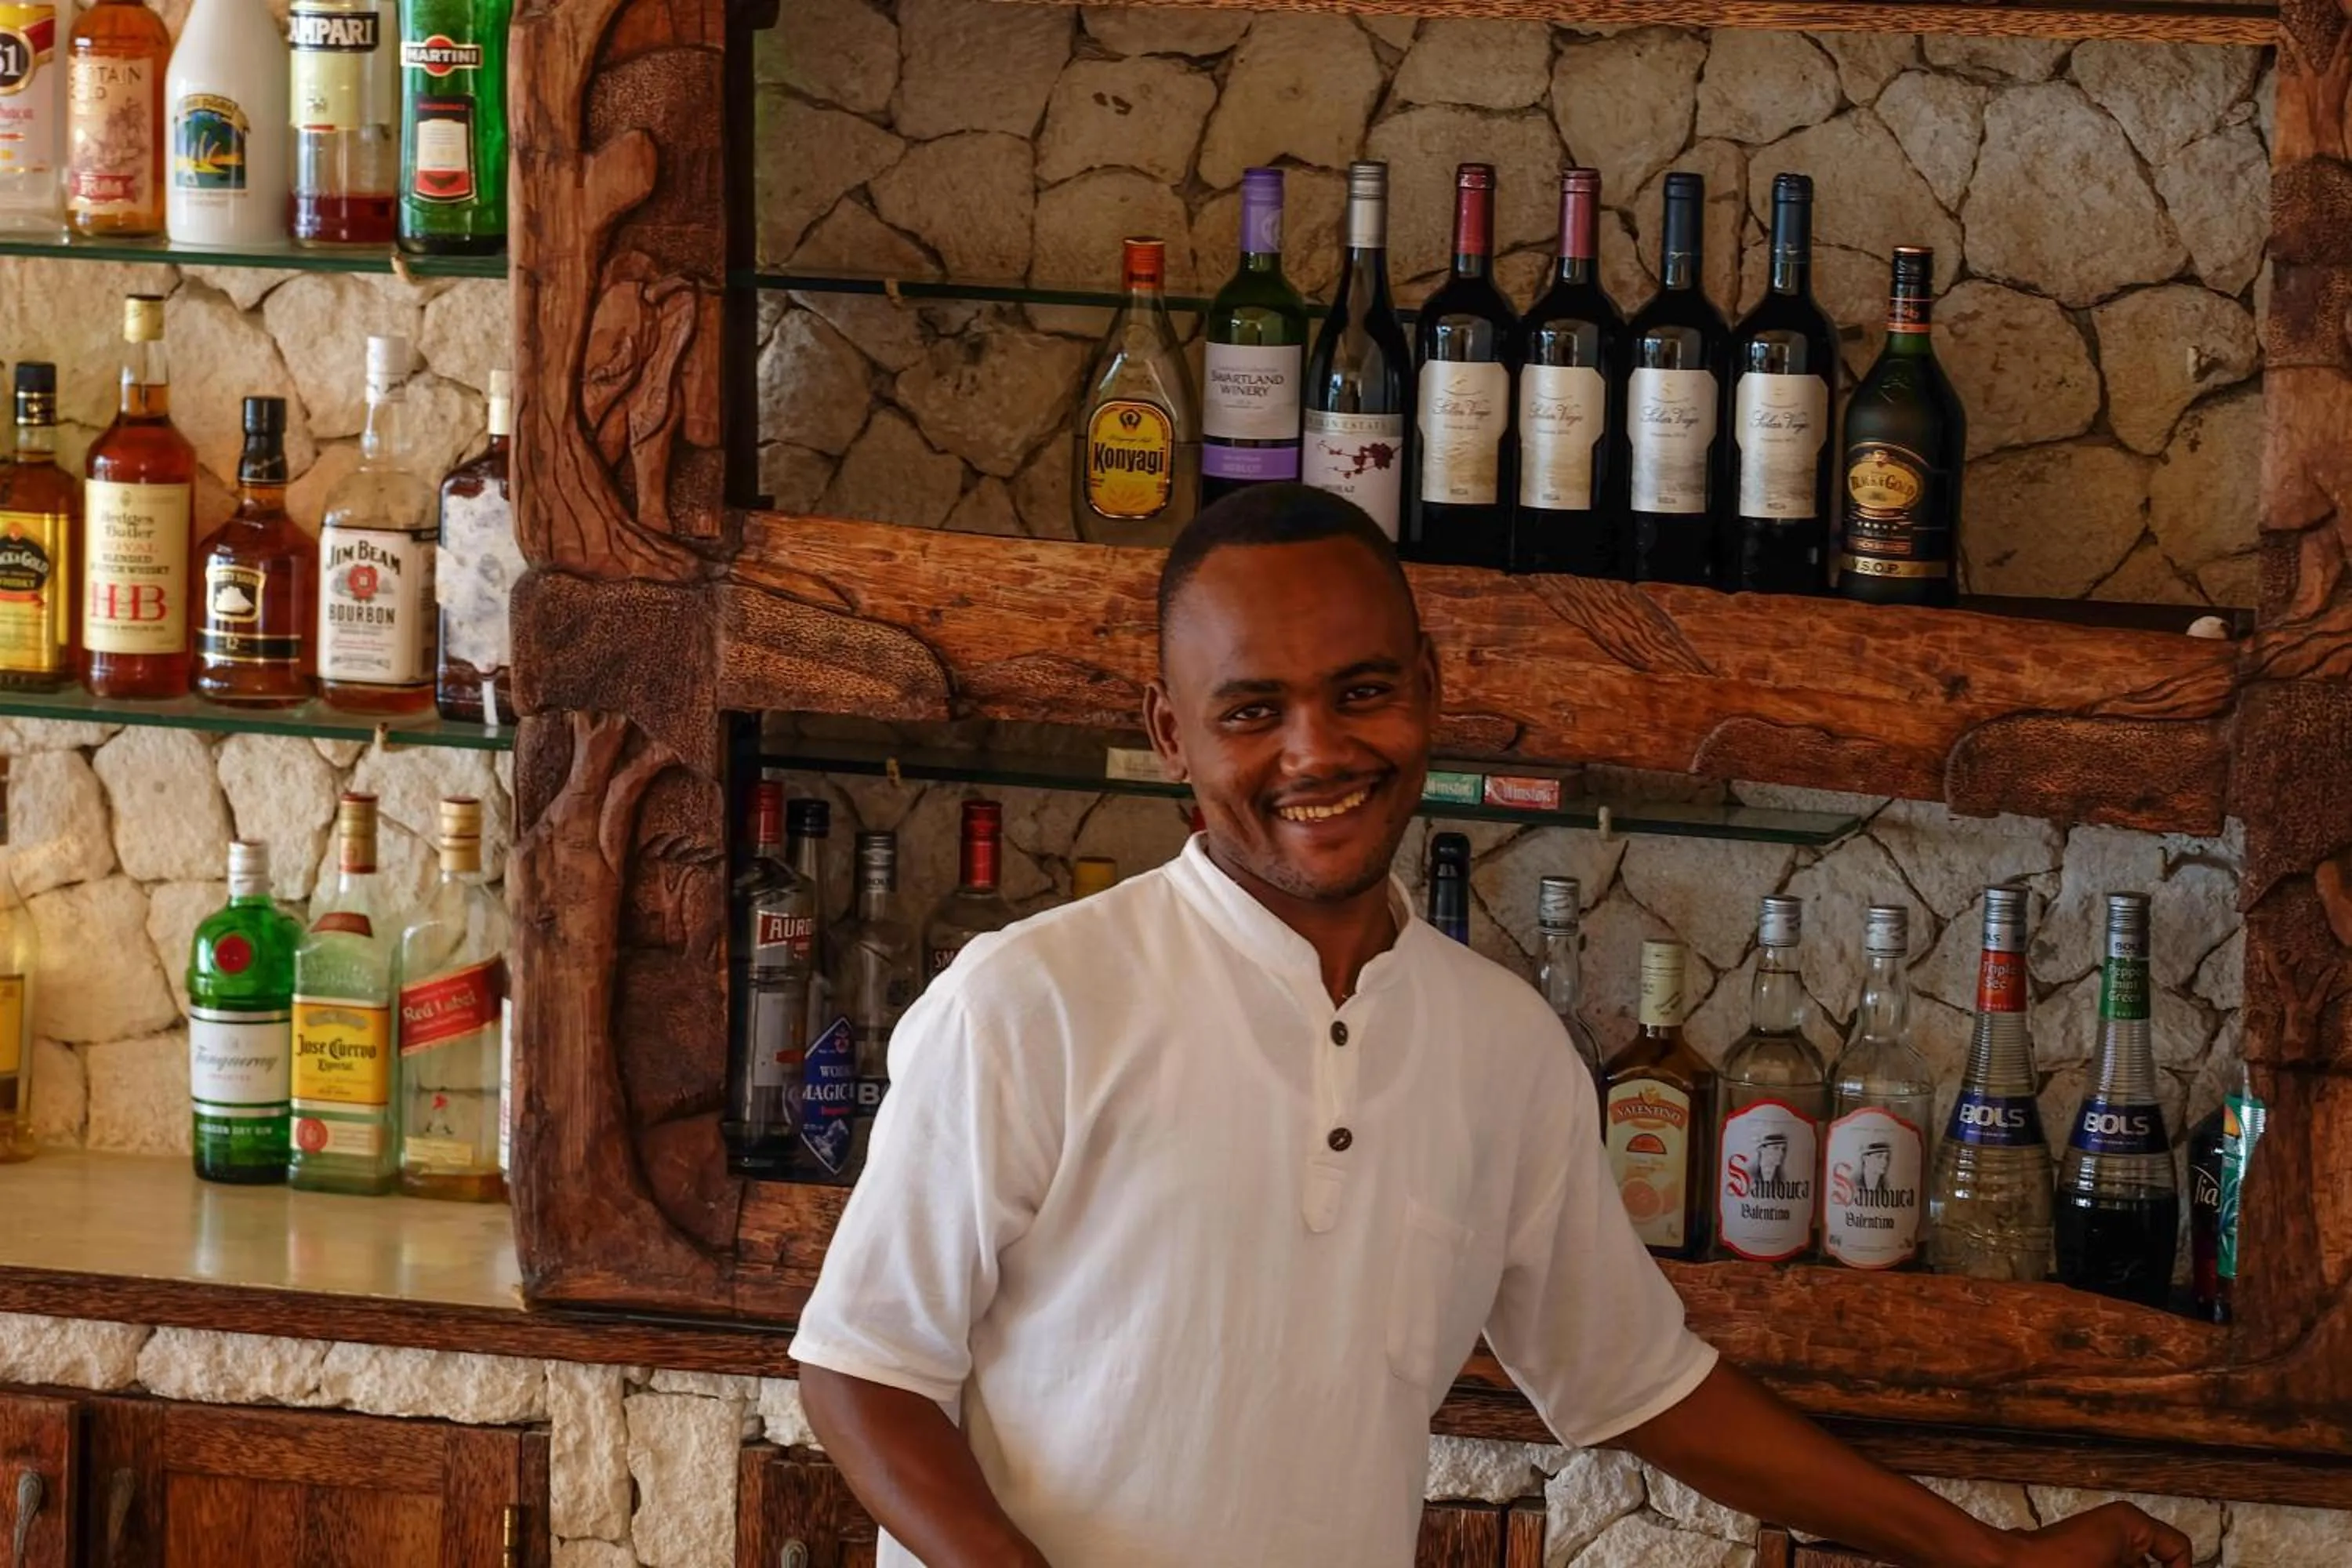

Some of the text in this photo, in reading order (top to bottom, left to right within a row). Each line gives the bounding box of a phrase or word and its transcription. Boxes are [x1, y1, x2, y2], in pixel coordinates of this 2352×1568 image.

[289, 17, 373, 45] AMPARI
[407, 49, 477, 63] MARTINI
[71, 64, 141, 85] TAIN
[1211, 370, 1285, 385] SWARTLAND
[1220, 384, 1269, 397] WINERY
[1094, 442, 1164, 475] Konyagi
[327, 539, 401, 575] JIM BEAM
[328, 604, 396, 624] BOURBON
[296, 1033, 377, 1060] Jose Cuervo
[1617, 1103, 1682, 1123] VALENTINO
[1959, 1103, 2026, 1128] BOLS
[2083, 1111, 2151, 1136] BOLS
[1726, 1153, 1810, 1200] Sambuca
[1831, 1163, 1915, 1208] Sambuca
